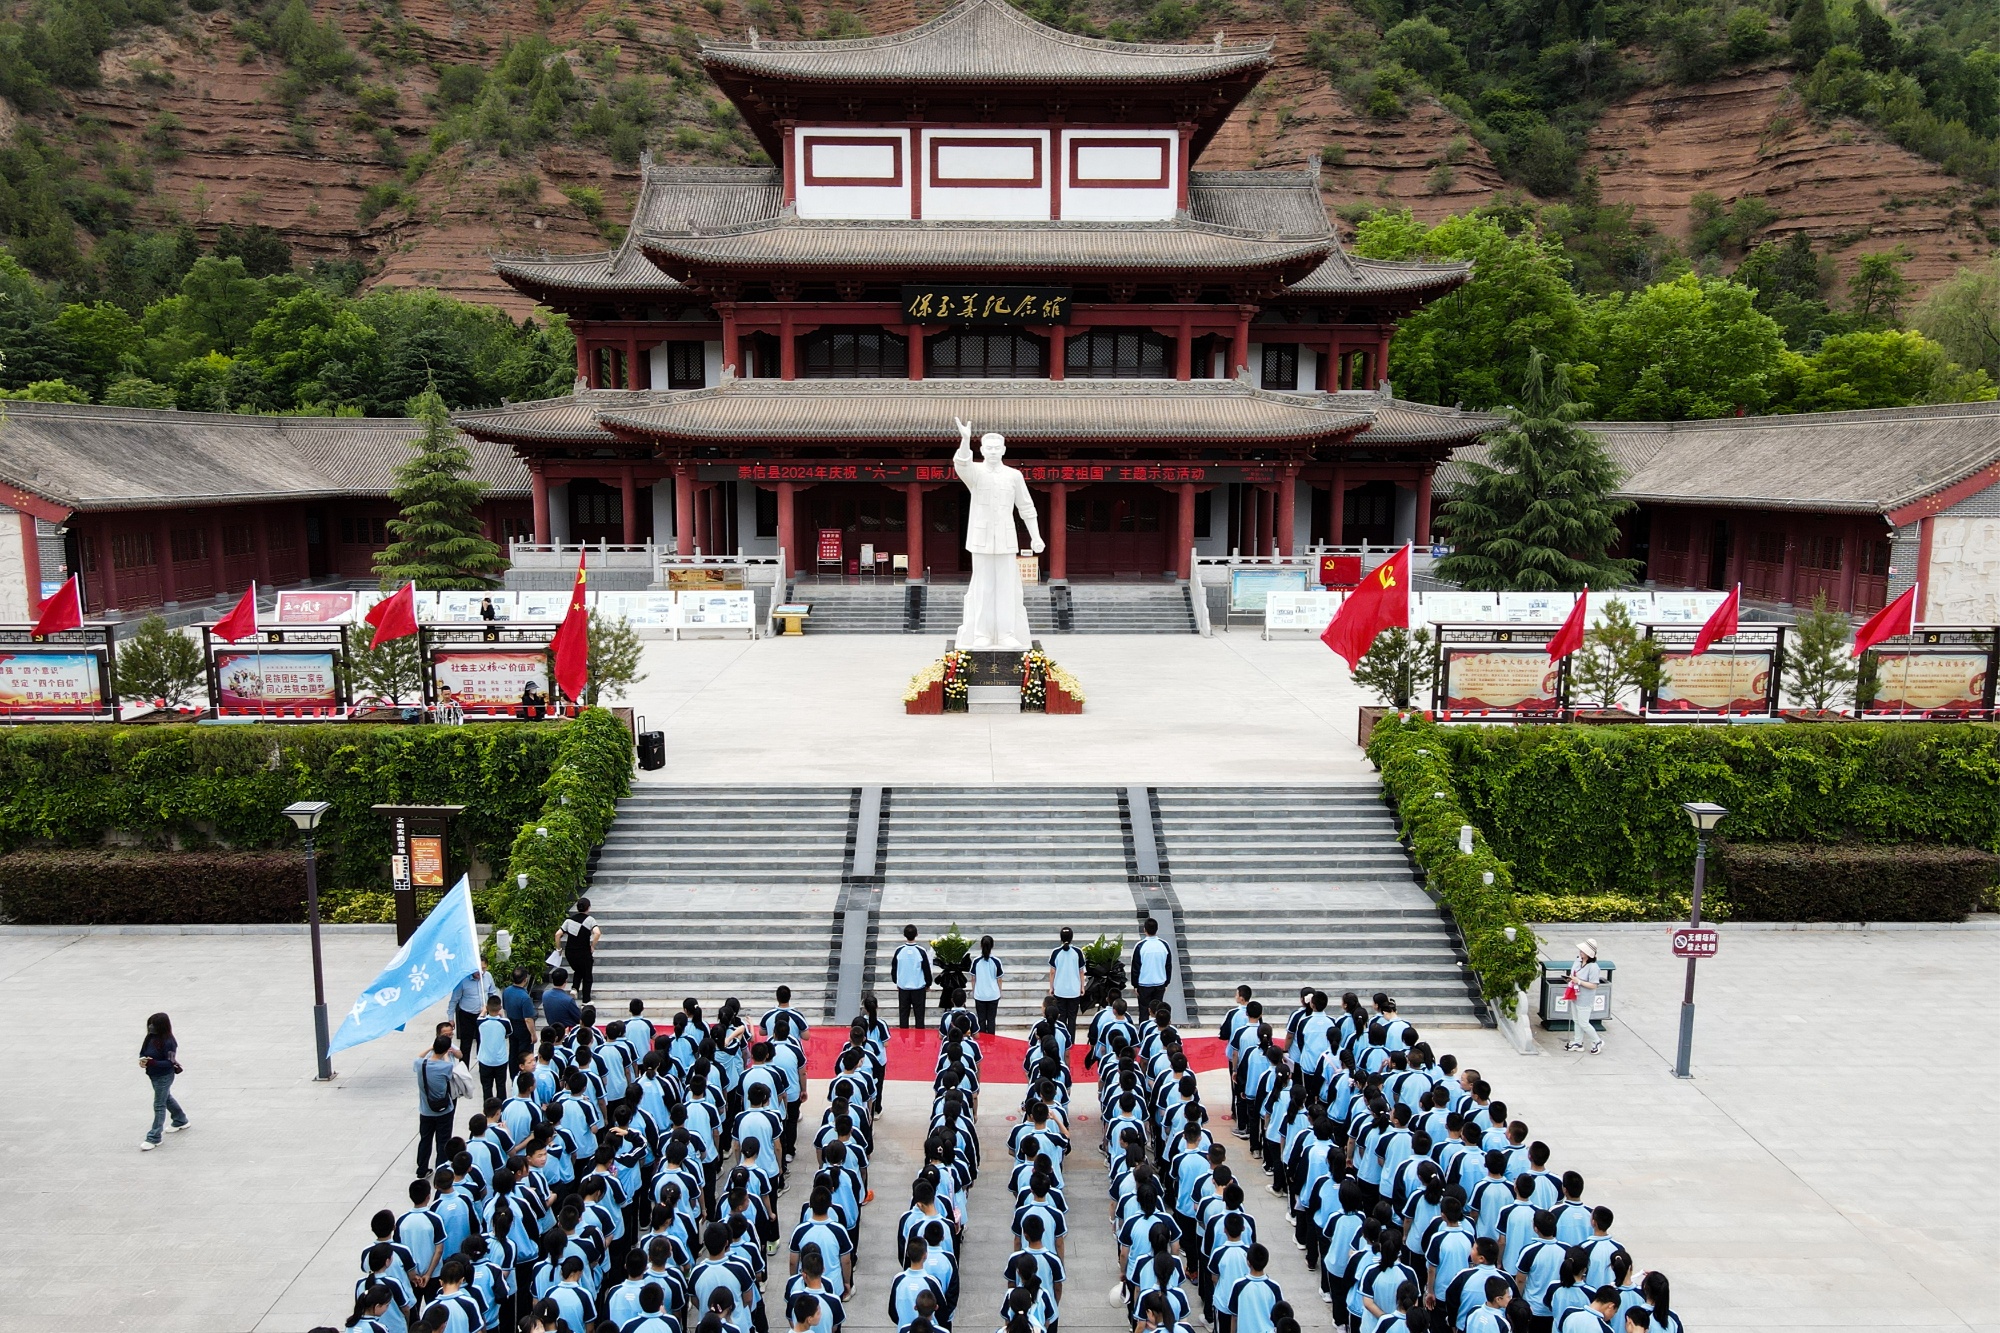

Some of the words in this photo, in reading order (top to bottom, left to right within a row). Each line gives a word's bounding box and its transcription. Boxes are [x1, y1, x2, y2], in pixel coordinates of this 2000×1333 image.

[451, 662, 536, 672] 社会主义核心价值观
[265, 674, 324, 683] 民族团结一家亲
[266, 684, 326, 694] 同心共筑中国梦
